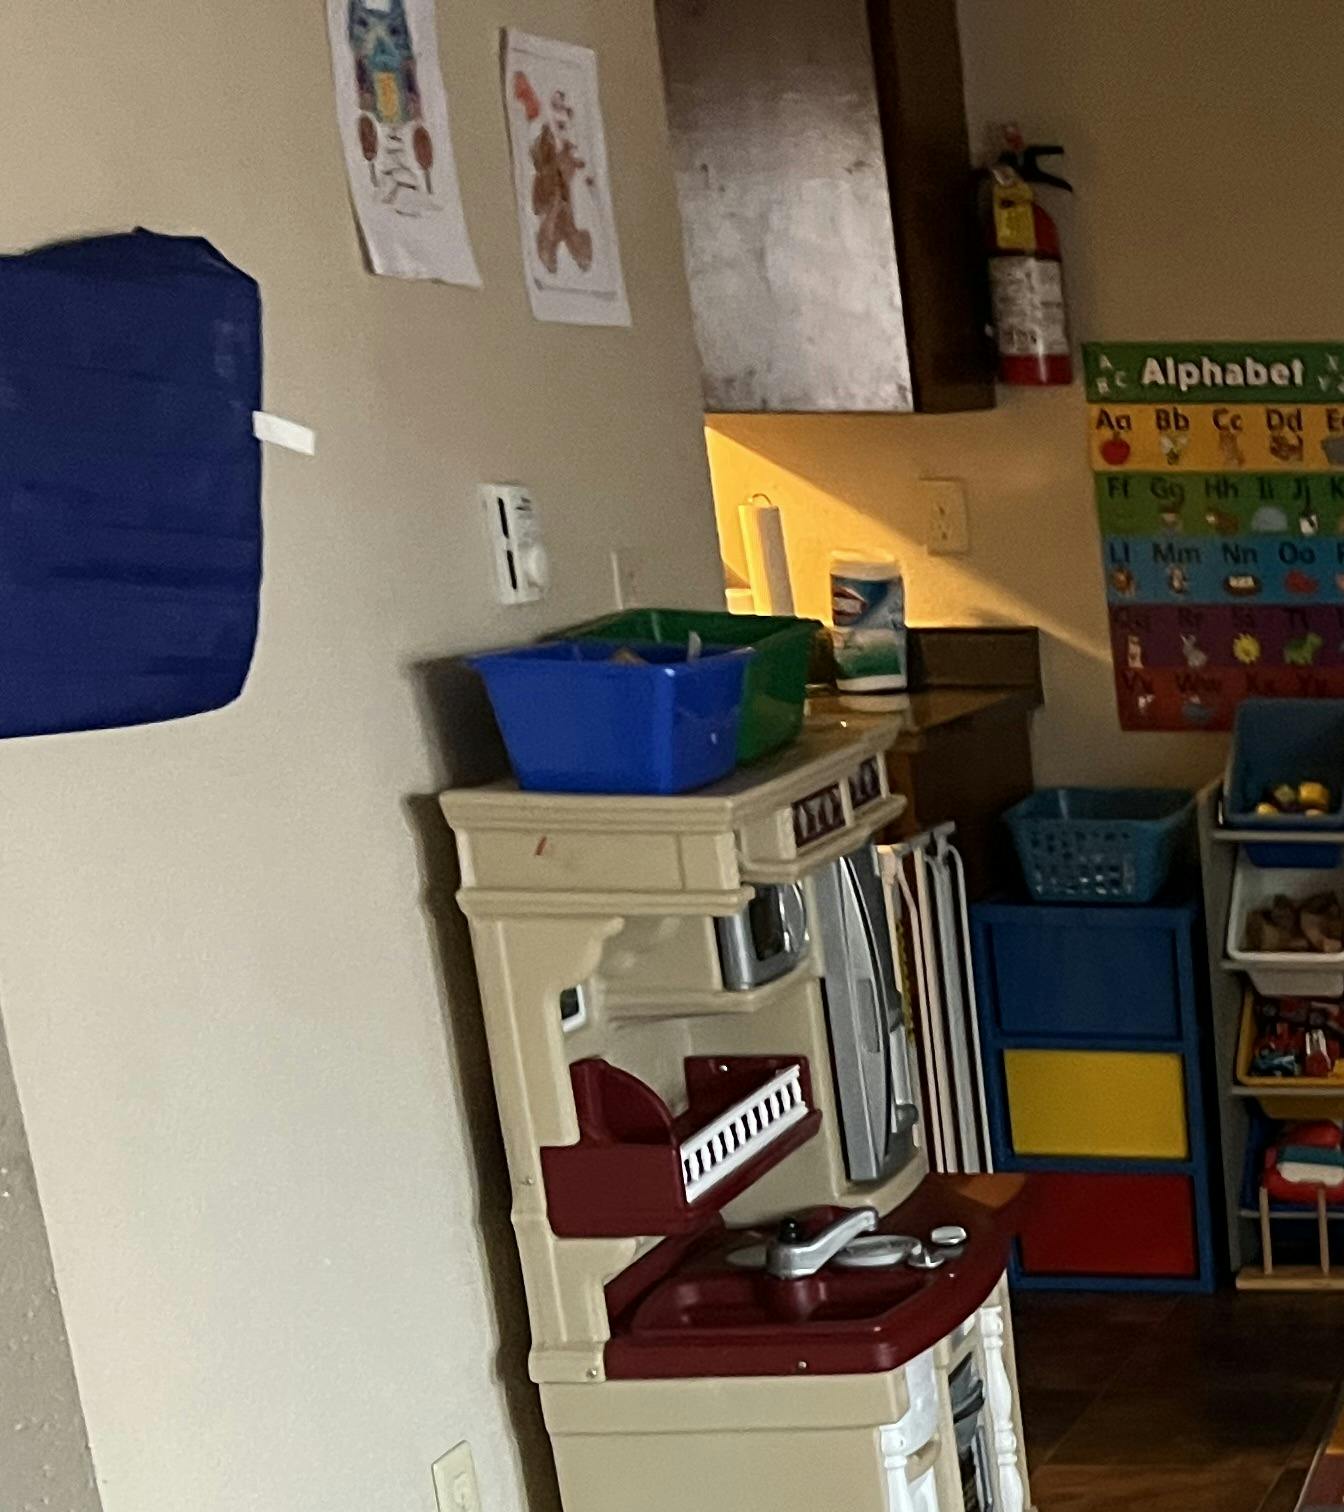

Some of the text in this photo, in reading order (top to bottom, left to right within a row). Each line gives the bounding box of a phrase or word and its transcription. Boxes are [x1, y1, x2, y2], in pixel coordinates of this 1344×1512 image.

[1141, 356, 1304, 393] Alphabet
[1096, 408, 1132, 432] Aa
[1155, 407, 1190, 432] Bb
[1212, 408, 1243, 432] Cc
[1266, 408, 1303, 432] Dd
[1204, 477, 1239, 499] Hh
[1152, 543, 1201, 564] Mm
[1221, 543, 1259, 564] Nn
[1278, 541, 1317, 565] Oo
